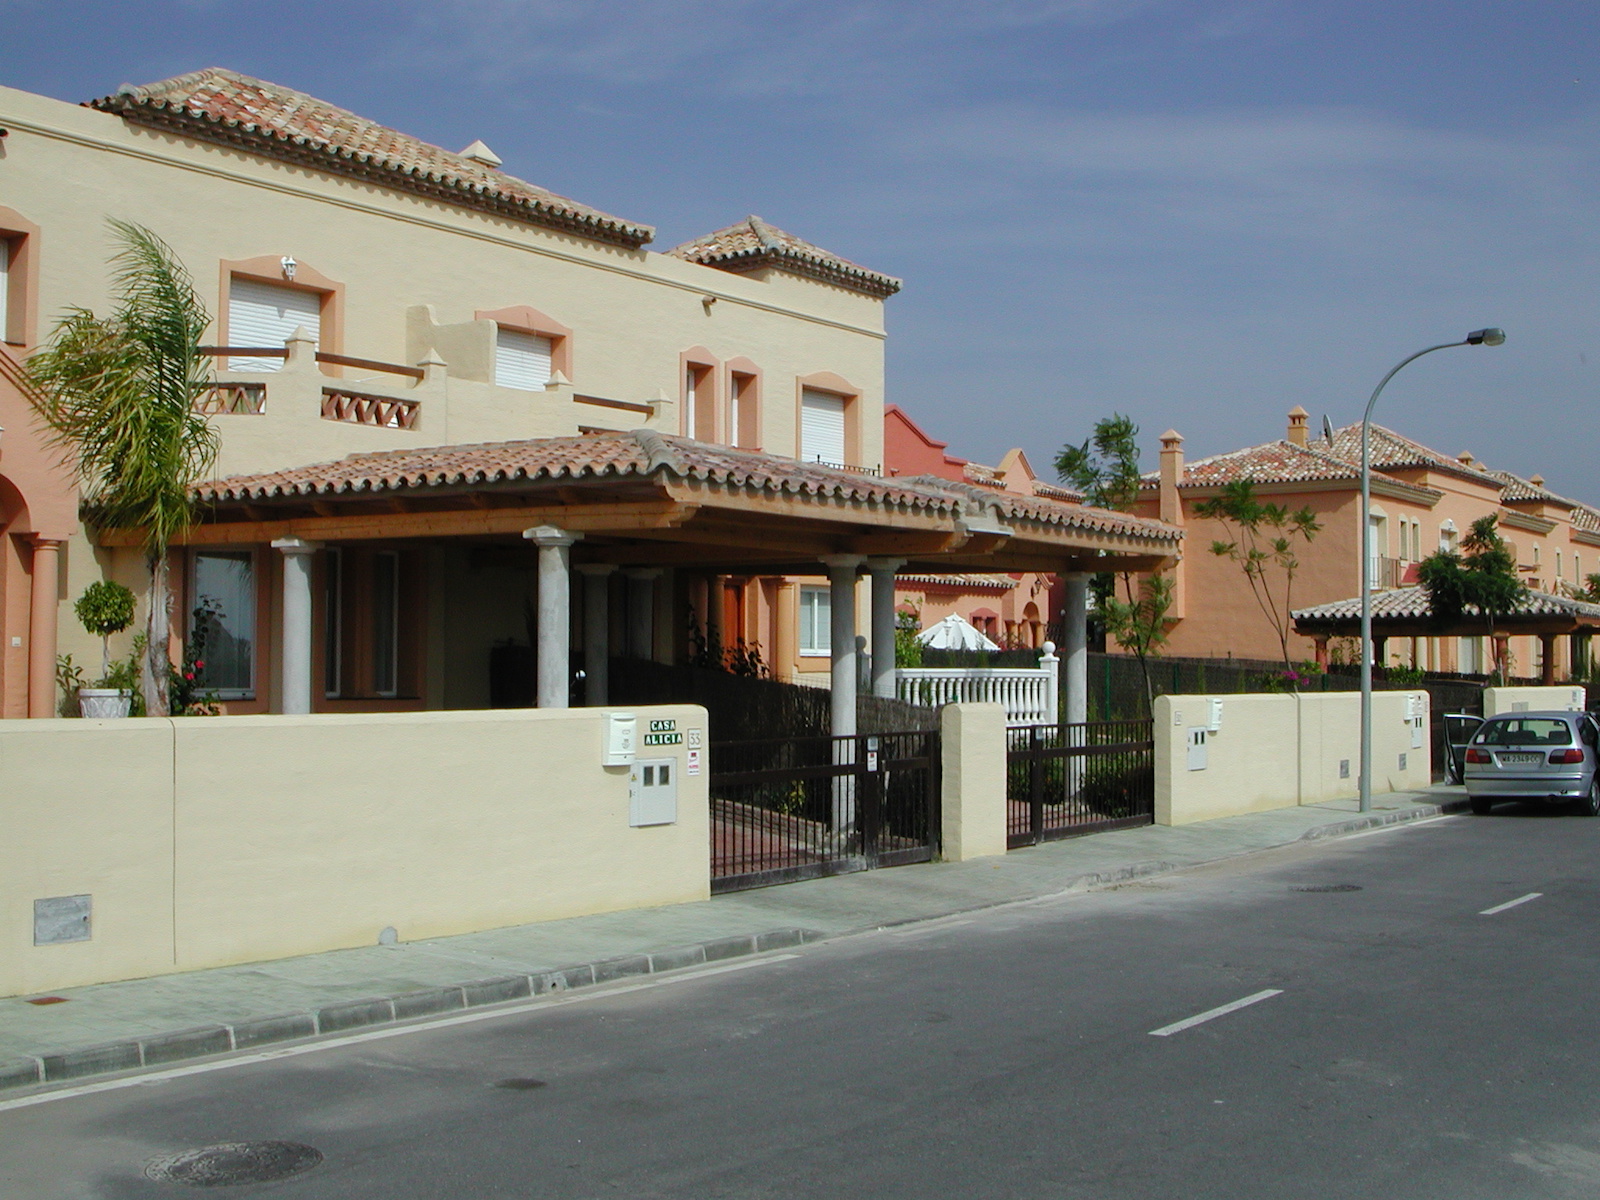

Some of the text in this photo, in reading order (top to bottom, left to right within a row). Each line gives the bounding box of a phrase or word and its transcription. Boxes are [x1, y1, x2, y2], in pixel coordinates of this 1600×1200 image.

[651, 720, 675, 731] CASA
[645, 733, 682, 744] ALICIA
[689, 732, 701, 745] 33
